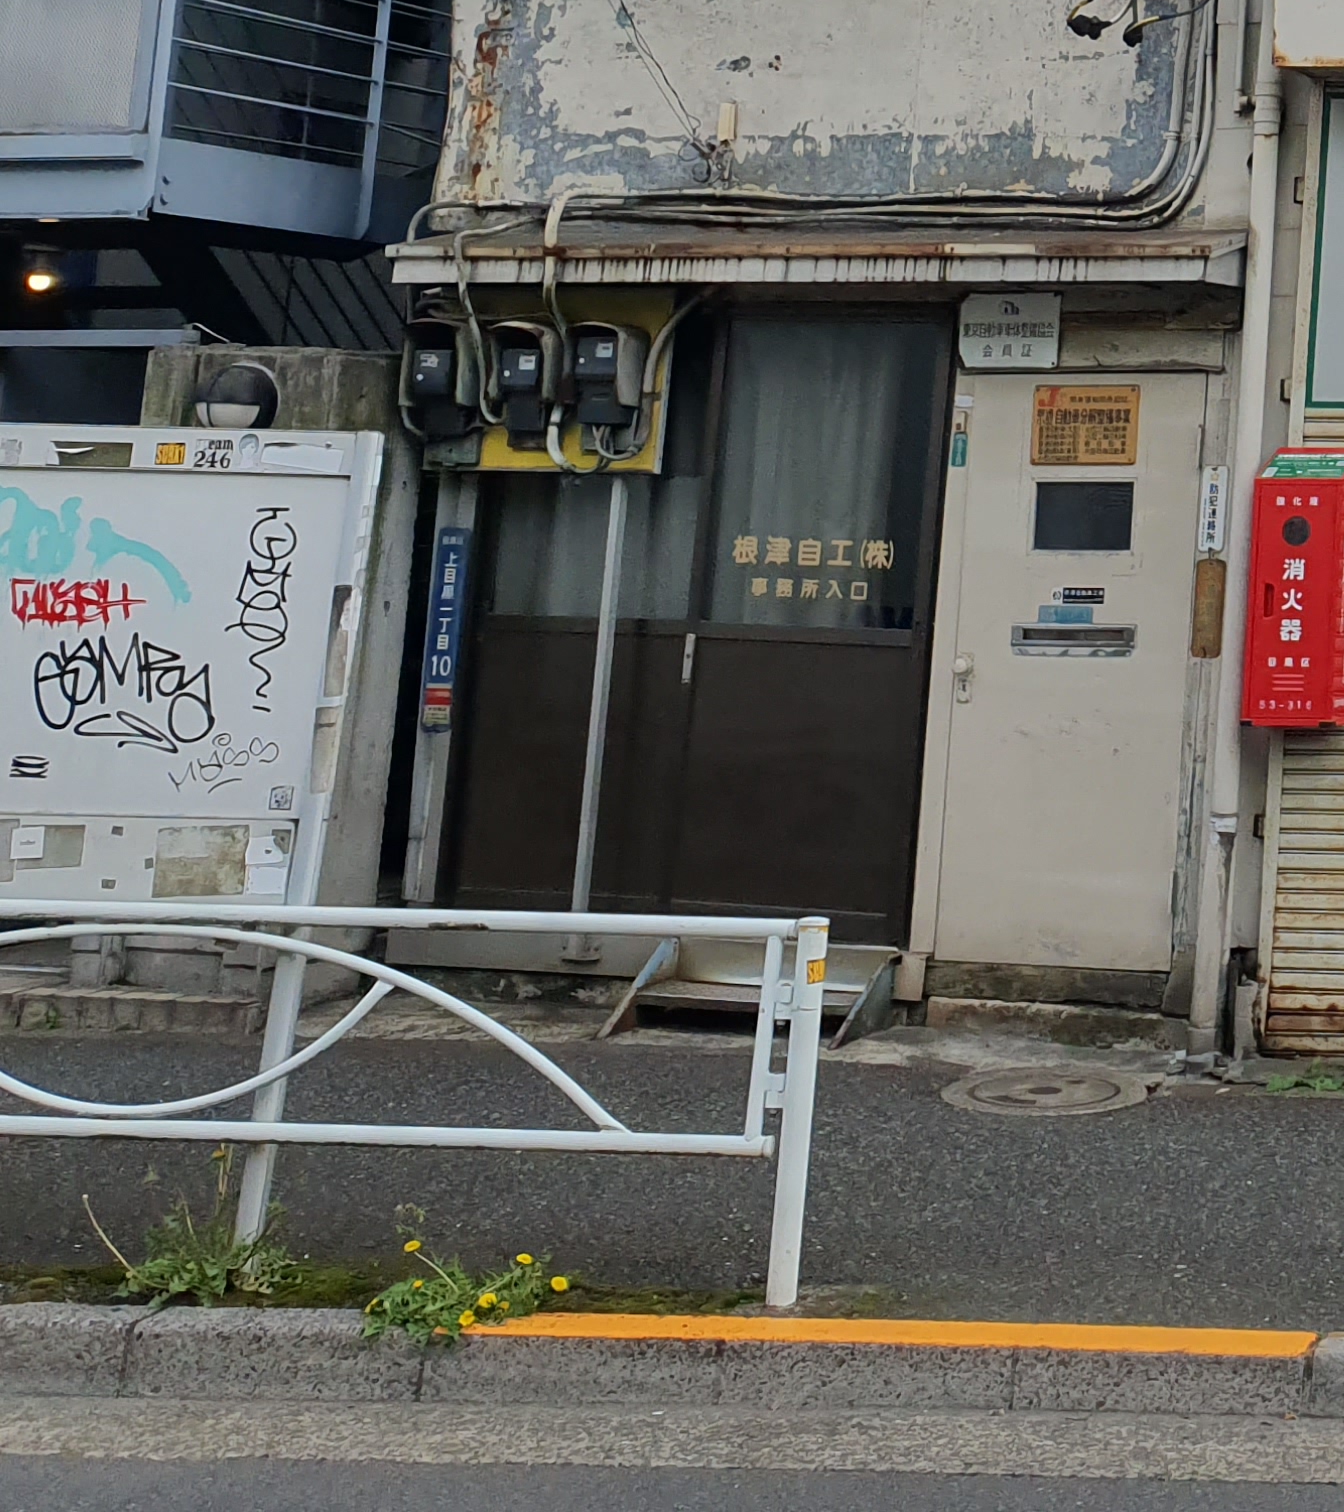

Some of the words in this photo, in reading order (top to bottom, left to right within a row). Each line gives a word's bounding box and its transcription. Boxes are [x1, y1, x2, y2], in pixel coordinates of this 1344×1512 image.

[198, 438, 234, 451] eam
[193, 449, 232, 469] 246
[436, 551, 458, 651] 上目黒一丁目
[1279, 557, 1306, 642] 消火器
[430, 654, 452, 677] 10
